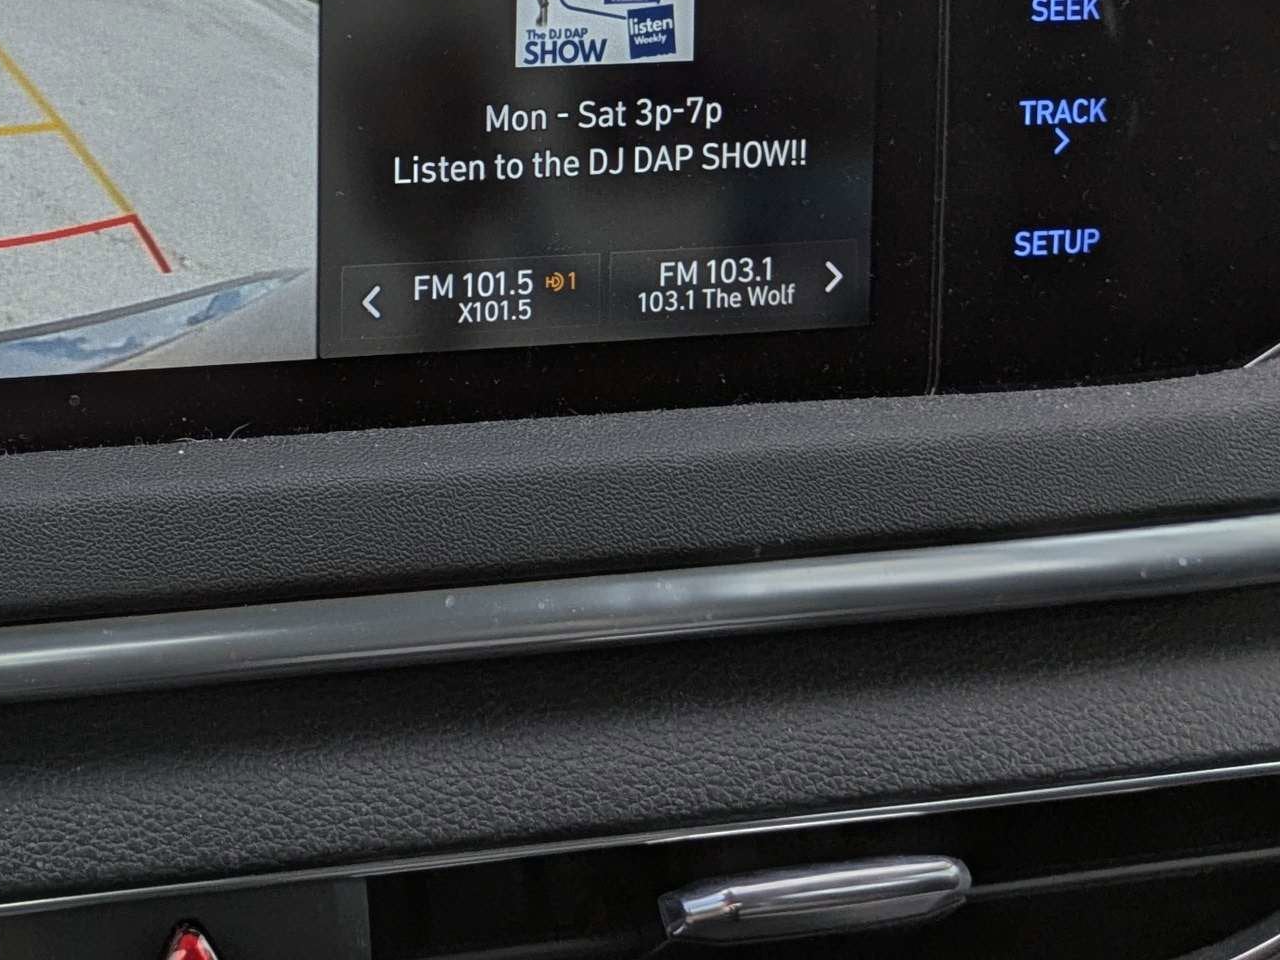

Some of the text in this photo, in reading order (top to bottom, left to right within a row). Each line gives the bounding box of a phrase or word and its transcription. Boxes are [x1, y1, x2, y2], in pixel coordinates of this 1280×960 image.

[526, 27, 588, 40] The DJ DAP
[629, 17, 673, 36] listen
[633, 33, 667, 46] Weekly
[523, 38, 608, 65] SHOW
[485, 104, 548, 133] Mon
[578, 100, 626, 130] Sat
[635, 96, 723, 131] 3p-7p
[1019, 97, 1108, 125] TRACK
[393, 138, 808, 184] Listen to the DJ DAP SHOW!!
[1014, 228, 1101, 257] SETUP
[414, 274, 454, 300] FM
[463, 269, 534, 298] 101.5
[659, 256, 774, 287] FM 103.1
[457, 299, 533, 323] X101.5
[637, 283, 796, 313] 103.1 The Wolf
